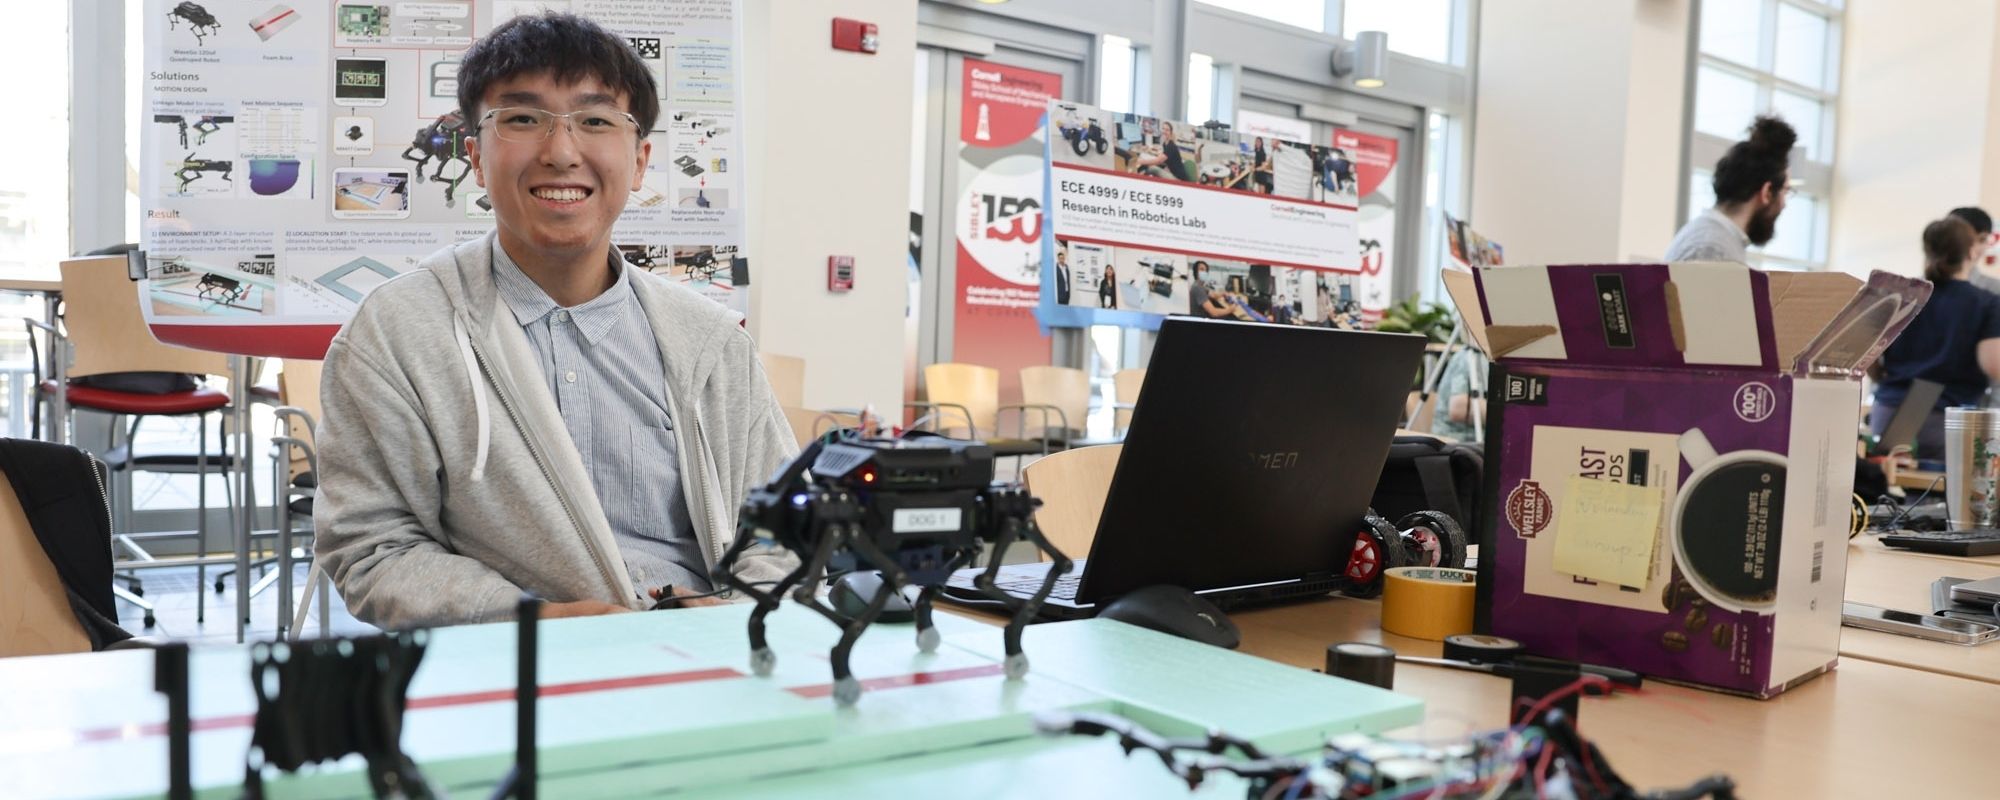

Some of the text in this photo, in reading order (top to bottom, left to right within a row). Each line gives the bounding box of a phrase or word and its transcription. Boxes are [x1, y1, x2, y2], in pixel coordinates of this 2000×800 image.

[150, 72, 200, 81] Solutions
[1062, 181, 1184, 208] ECE 4999 / ECE 5999
[148, 210, 180, 219] Result
[970, 191, 980, 240] SIBLEY
[982, 194, 1043, 244] 150
[1062, 199, 1207, 229] Research in Robotics Labs
[1511, 381, 1522, 396] 100
[1522, 484, 1536, 535] WELLSLEY
[909, 514, 936, 526] DOG
[1440, 570, 1464, 580] DUCK
[1754, 566, 1764, 579] NET
